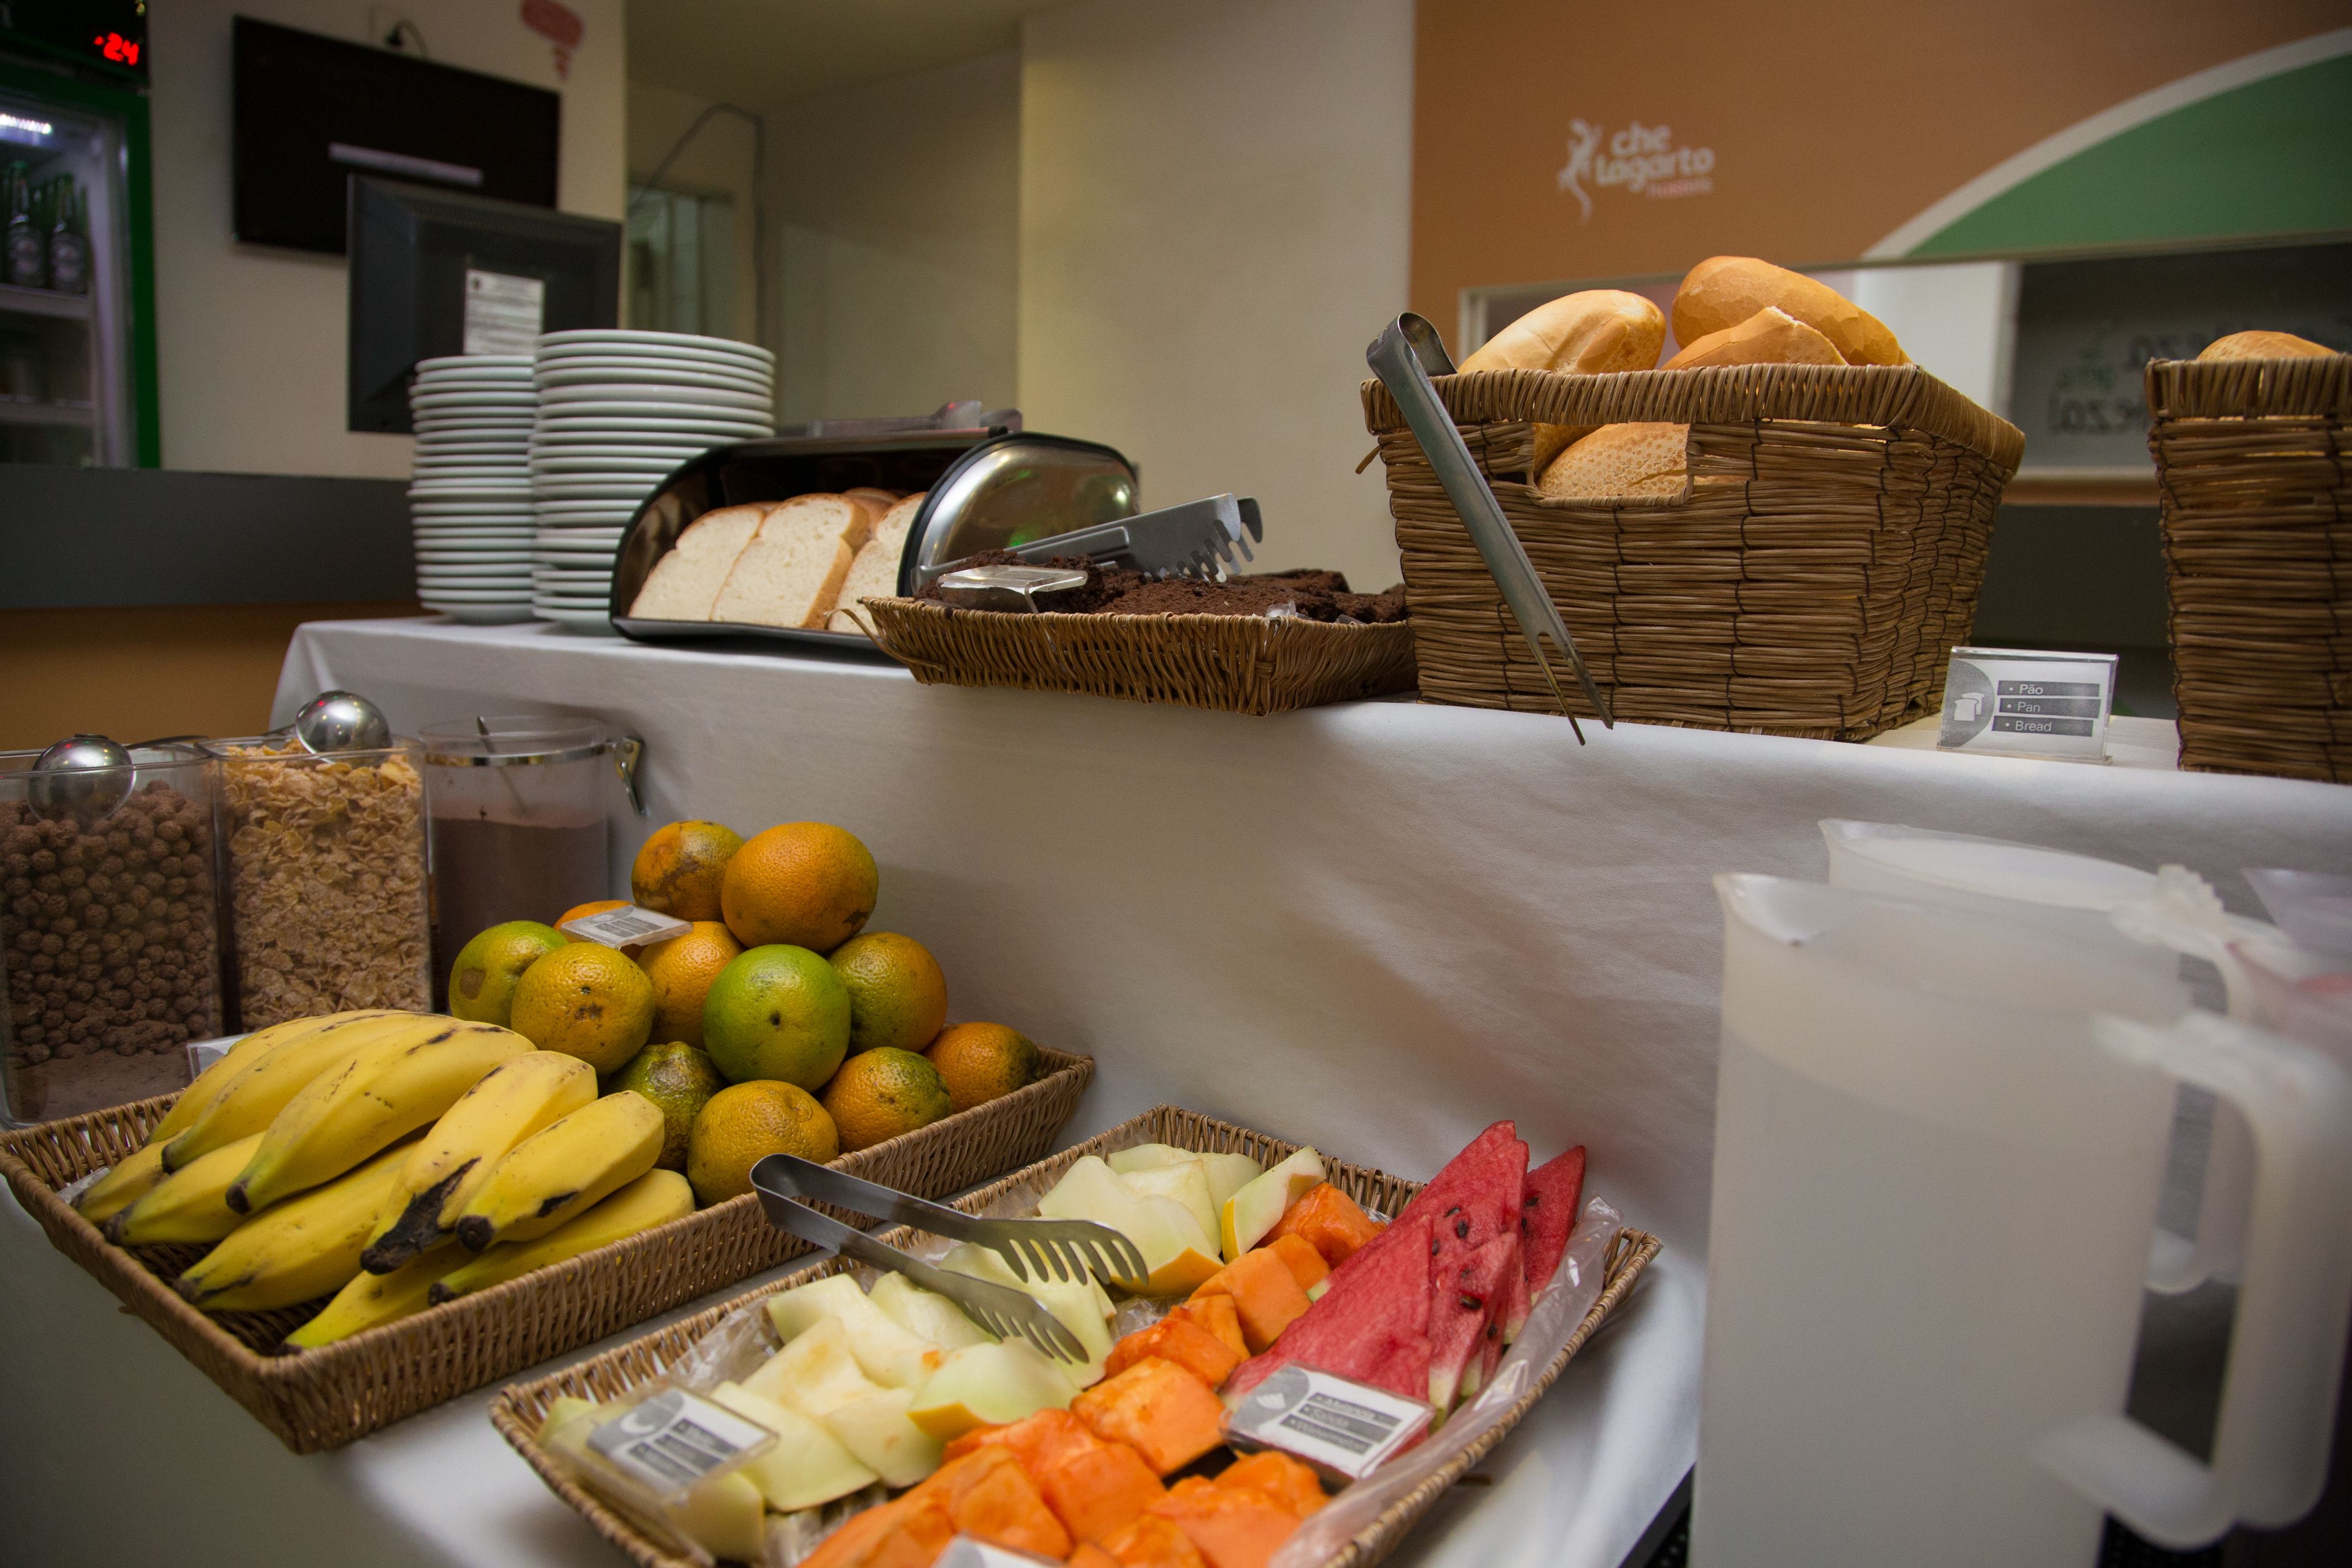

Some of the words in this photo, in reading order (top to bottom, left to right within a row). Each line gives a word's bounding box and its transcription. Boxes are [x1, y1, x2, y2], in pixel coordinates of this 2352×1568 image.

[1611, 121, 1671, 156] che
[2019, 684, 2043, 695] Pão
[2018, 702, 2040, 712] Pan
[2015, 721, 2052, 731] Bread
